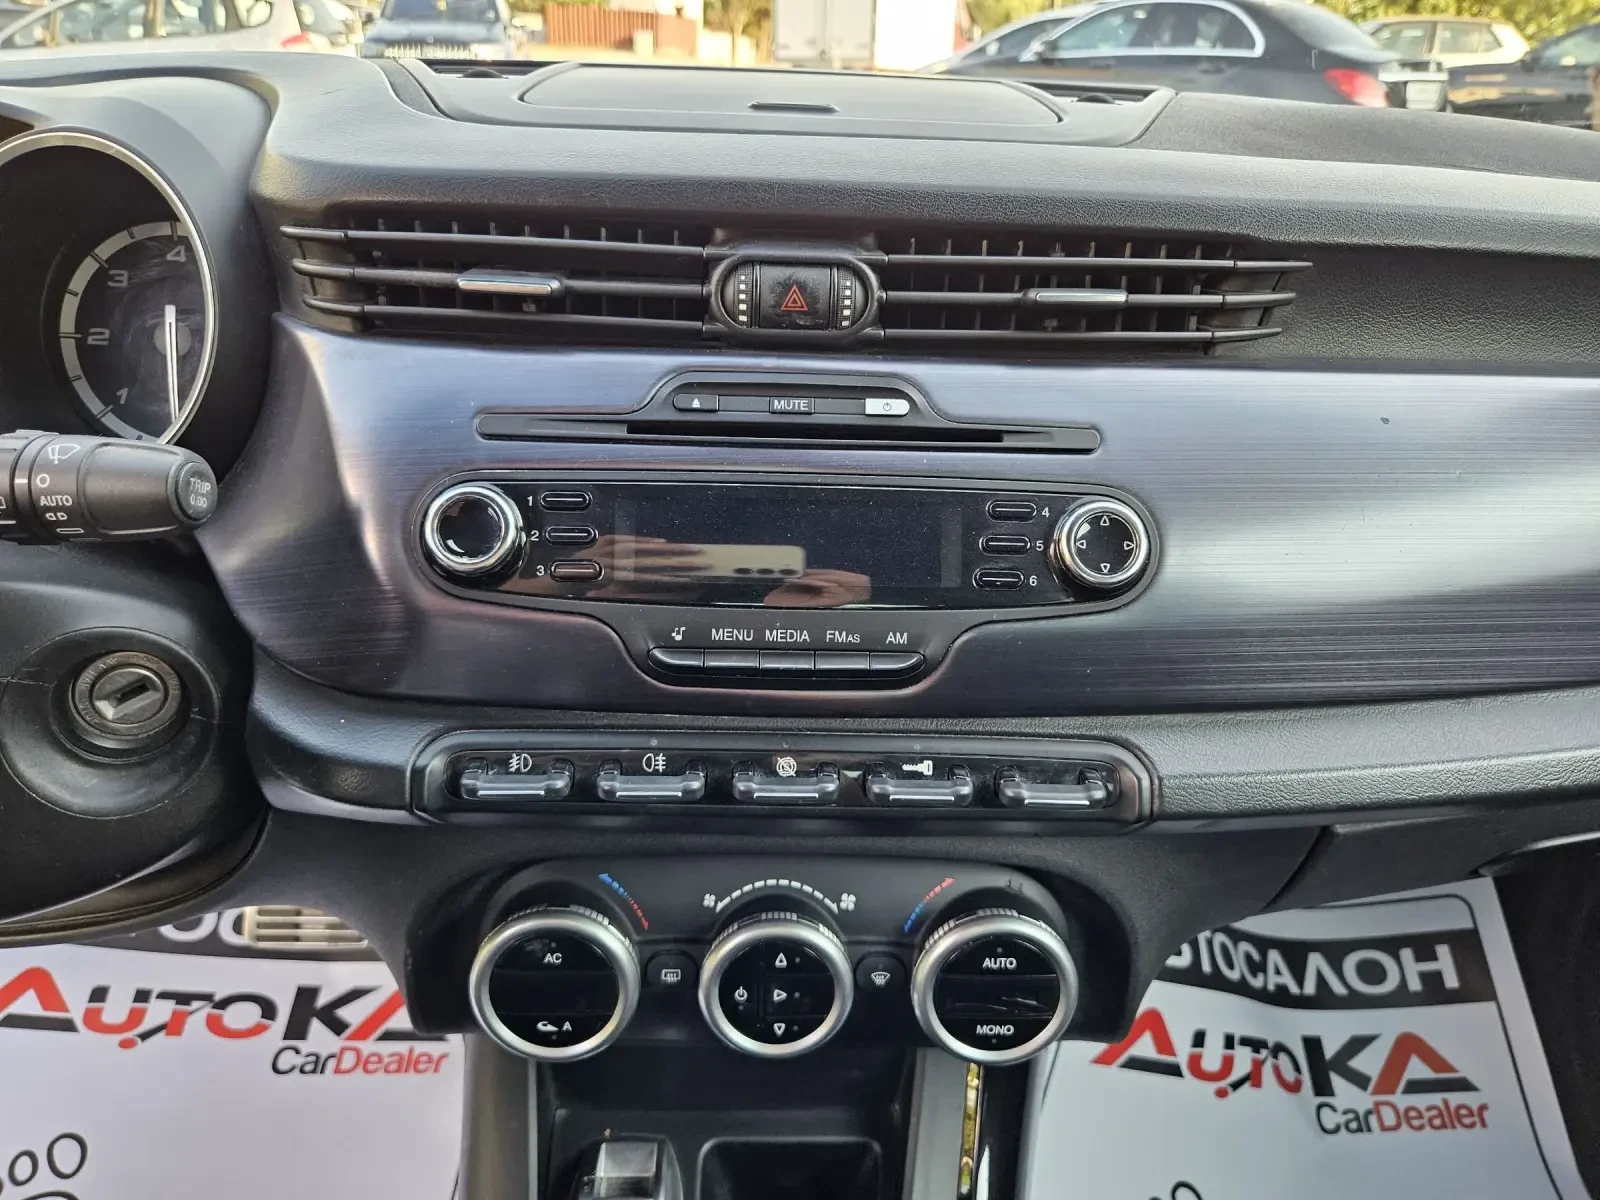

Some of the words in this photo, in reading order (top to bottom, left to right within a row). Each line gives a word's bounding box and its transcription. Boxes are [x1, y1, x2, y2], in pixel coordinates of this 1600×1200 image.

[166, 245, 187, 263] 4
[107, 269, 129, 288] 3
[87, 328, 111, 345] 2
[116, 387, 129, 404] 1
[773, 399, 809, 411] MUTE
[189, 477, 212, 492] TRIP
[40, 495, 73, 507] AUTO
[527, 496, 533, 506] 1
[1042, 507, 1050, 518] 4
[530, 530, 539, 541] 2
[1036, 540, 1044, 551] 5
[536, 565, 545, 576] 3
[1029, 575, 1038, 586] 6
[711, 628, 754, 641] MENU
[765, 629, 811, 643] MEDIA
[886, 632, 908, 645] AM
[543, 953, 563, 966] AC
[982, 957, 1017, 971] AUTO
[561, 1021, 573, 1032] A
[976, 1024, 1015, 1036] MONO
[271, 1044, 450, 1076] CarDealer
[1314, 1097, 1490, 1136] CarDealer
